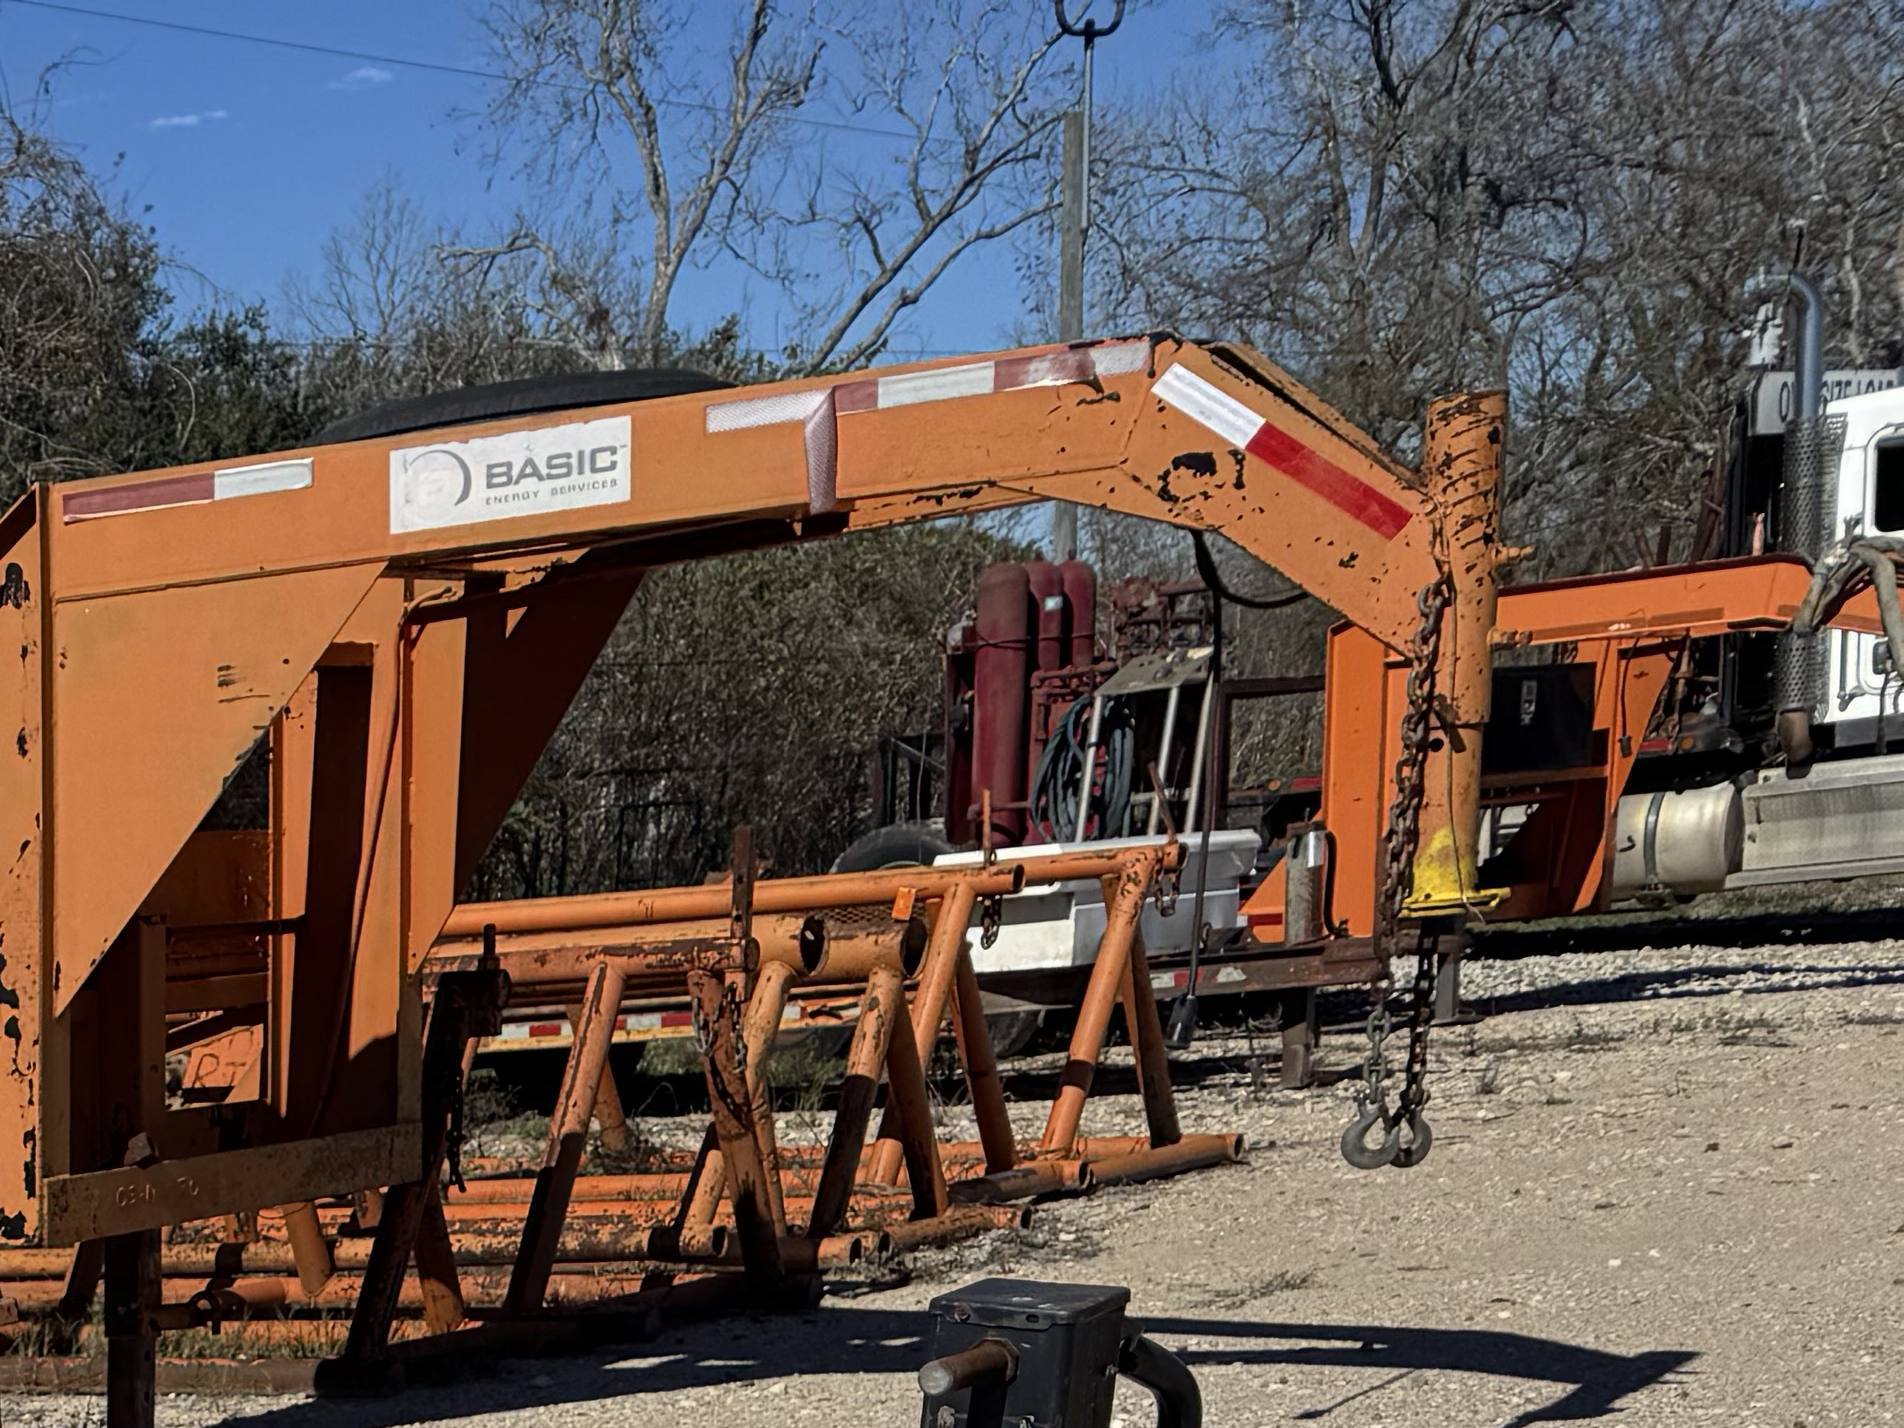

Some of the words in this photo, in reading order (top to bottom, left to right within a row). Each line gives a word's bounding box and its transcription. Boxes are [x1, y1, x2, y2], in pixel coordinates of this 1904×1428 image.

[485, 445, 618, 490] BASIC
[484, 489, 541, 506] ENERGY
[550, 477, 619, 497] SERVICES
